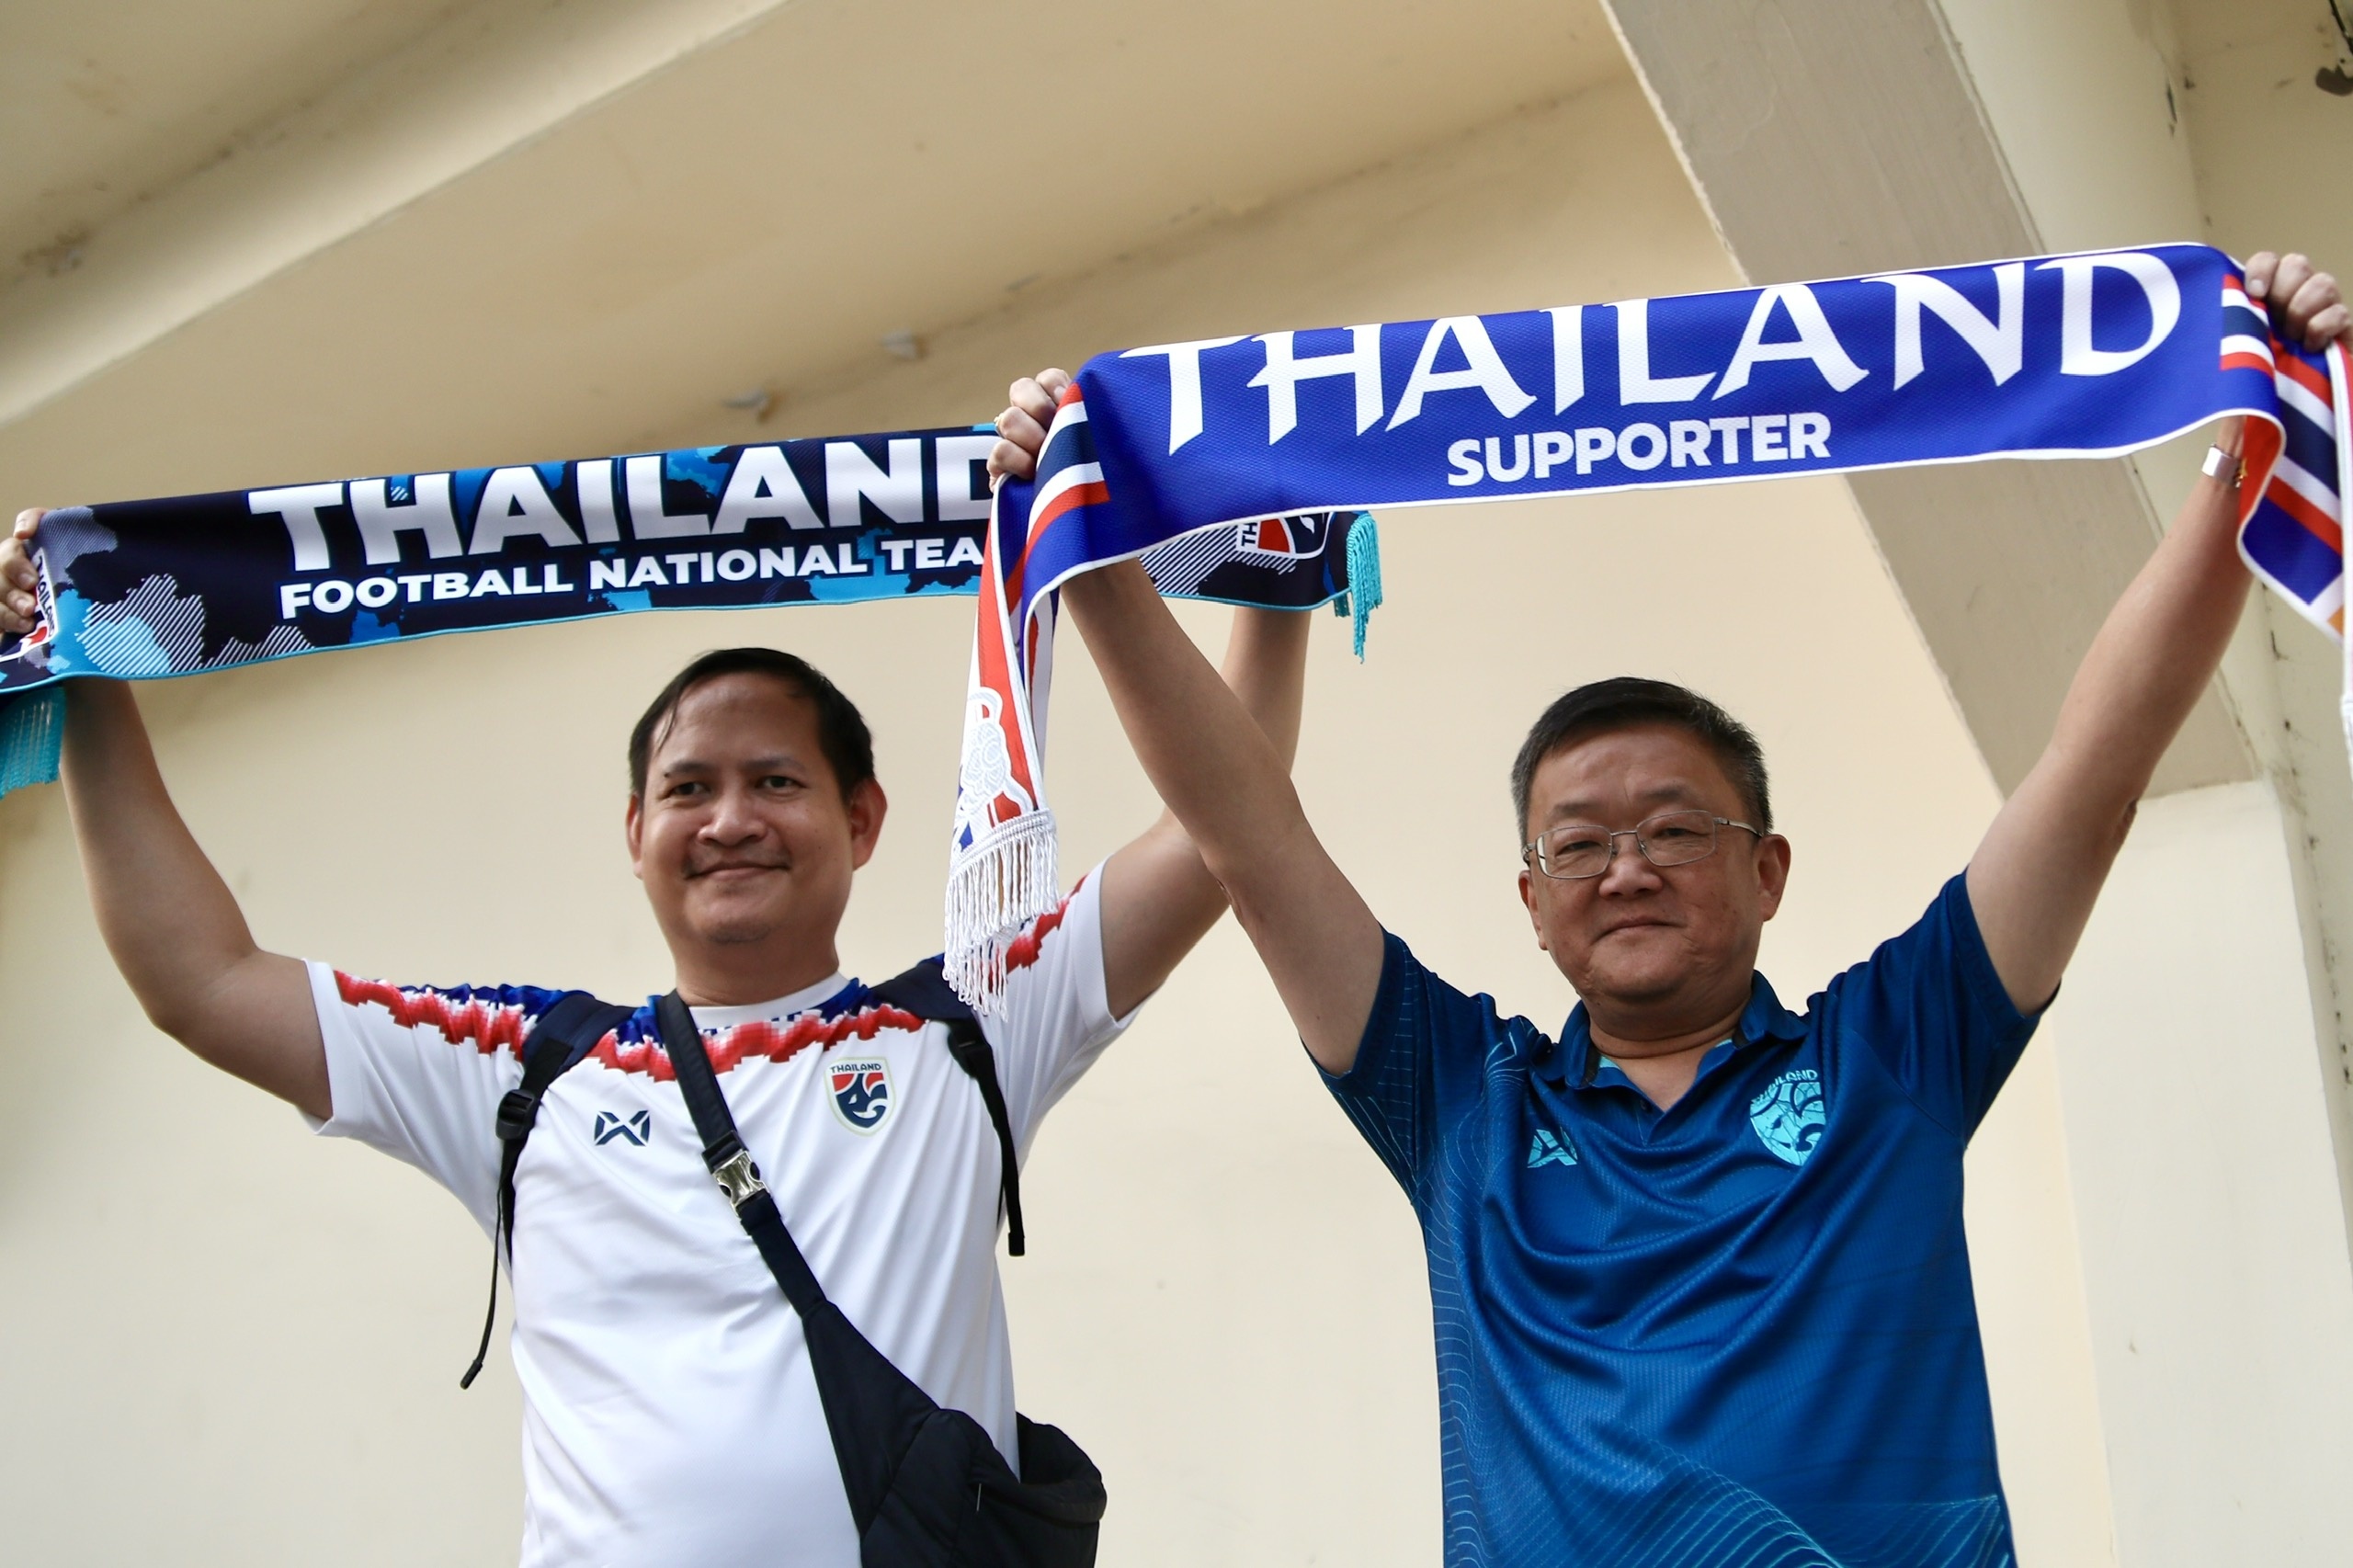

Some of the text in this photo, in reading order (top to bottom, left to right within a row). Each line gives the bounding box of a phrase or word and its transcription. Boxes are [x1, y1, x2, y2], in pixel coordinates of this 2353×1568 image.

[1118, 252, 2182, 456] THAILAND
[1447, 412, 1832, 487] SUPPORTER
[280, 537, 984, 620] FOOTBALL NATIONAL TEA
[830, 1062, 882, 1074] THAILAND
